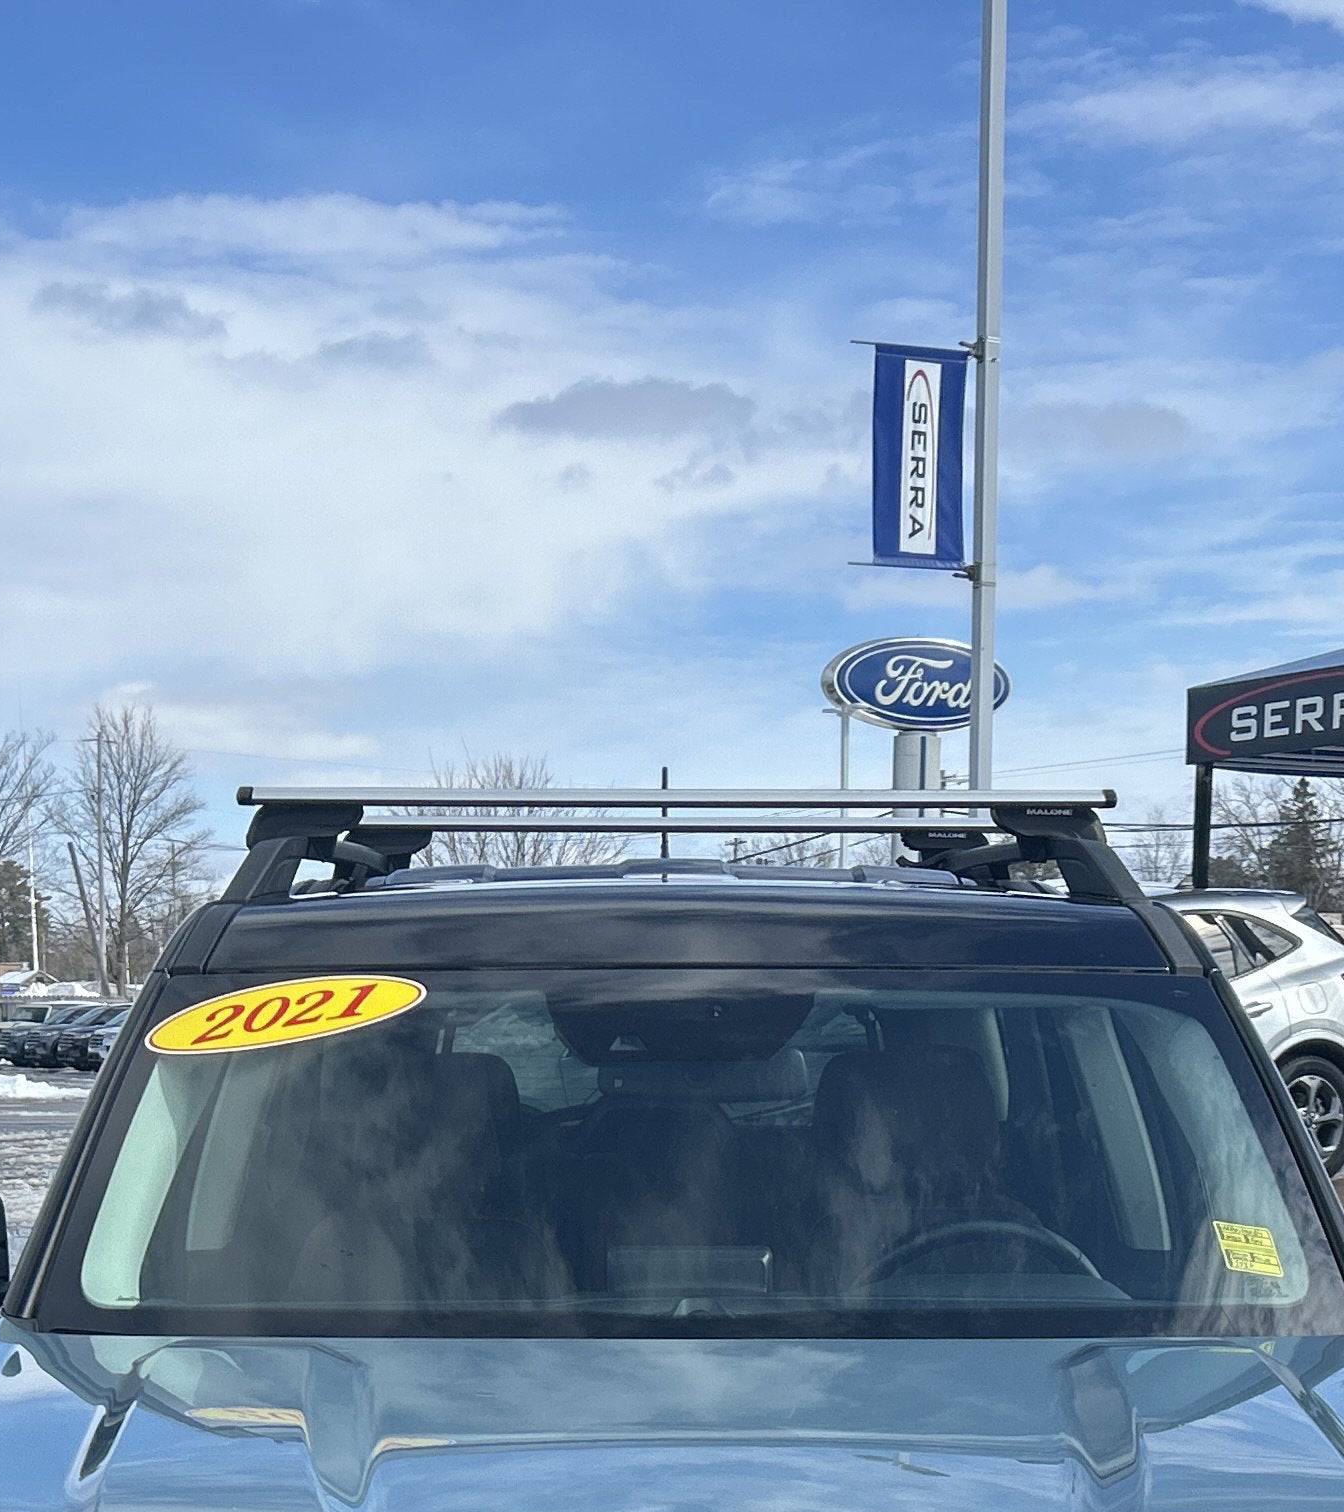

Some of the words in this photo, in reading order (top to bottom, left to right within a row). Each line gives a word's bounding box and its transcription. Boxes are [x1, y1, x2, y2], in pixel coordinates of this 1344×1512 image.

[908, 402, 929, 539] SERRA
[1026, 808, 1073, 816] MALONE
[191, 983, 379, 1045] 2021
